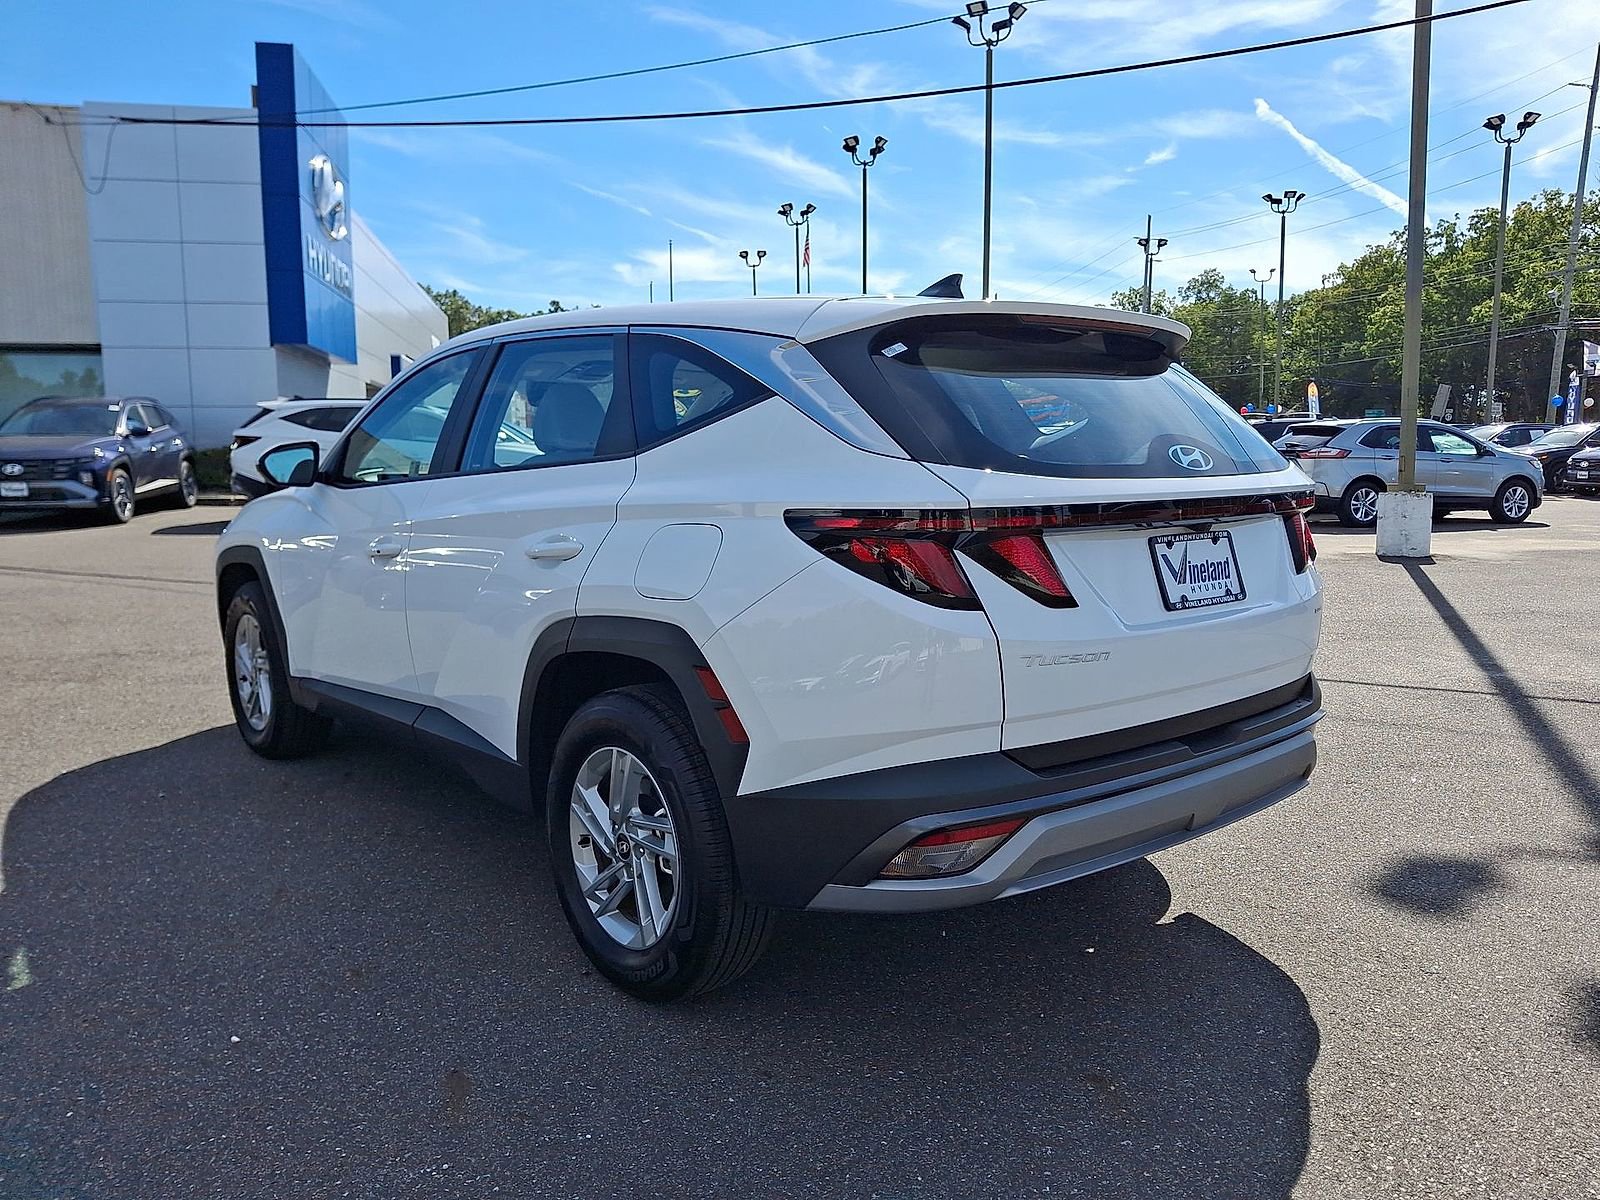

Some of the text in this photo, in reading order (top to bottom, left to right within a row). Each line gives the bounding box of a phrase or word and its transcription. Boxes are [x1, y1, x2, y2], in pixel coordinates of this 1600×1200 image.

[1160, 541, 1231, 585] Vineland
[1190, 581, 1233, 594] HYUNDAI
[1184, 595, 1236, 608] VINELAND HYUNDAI
